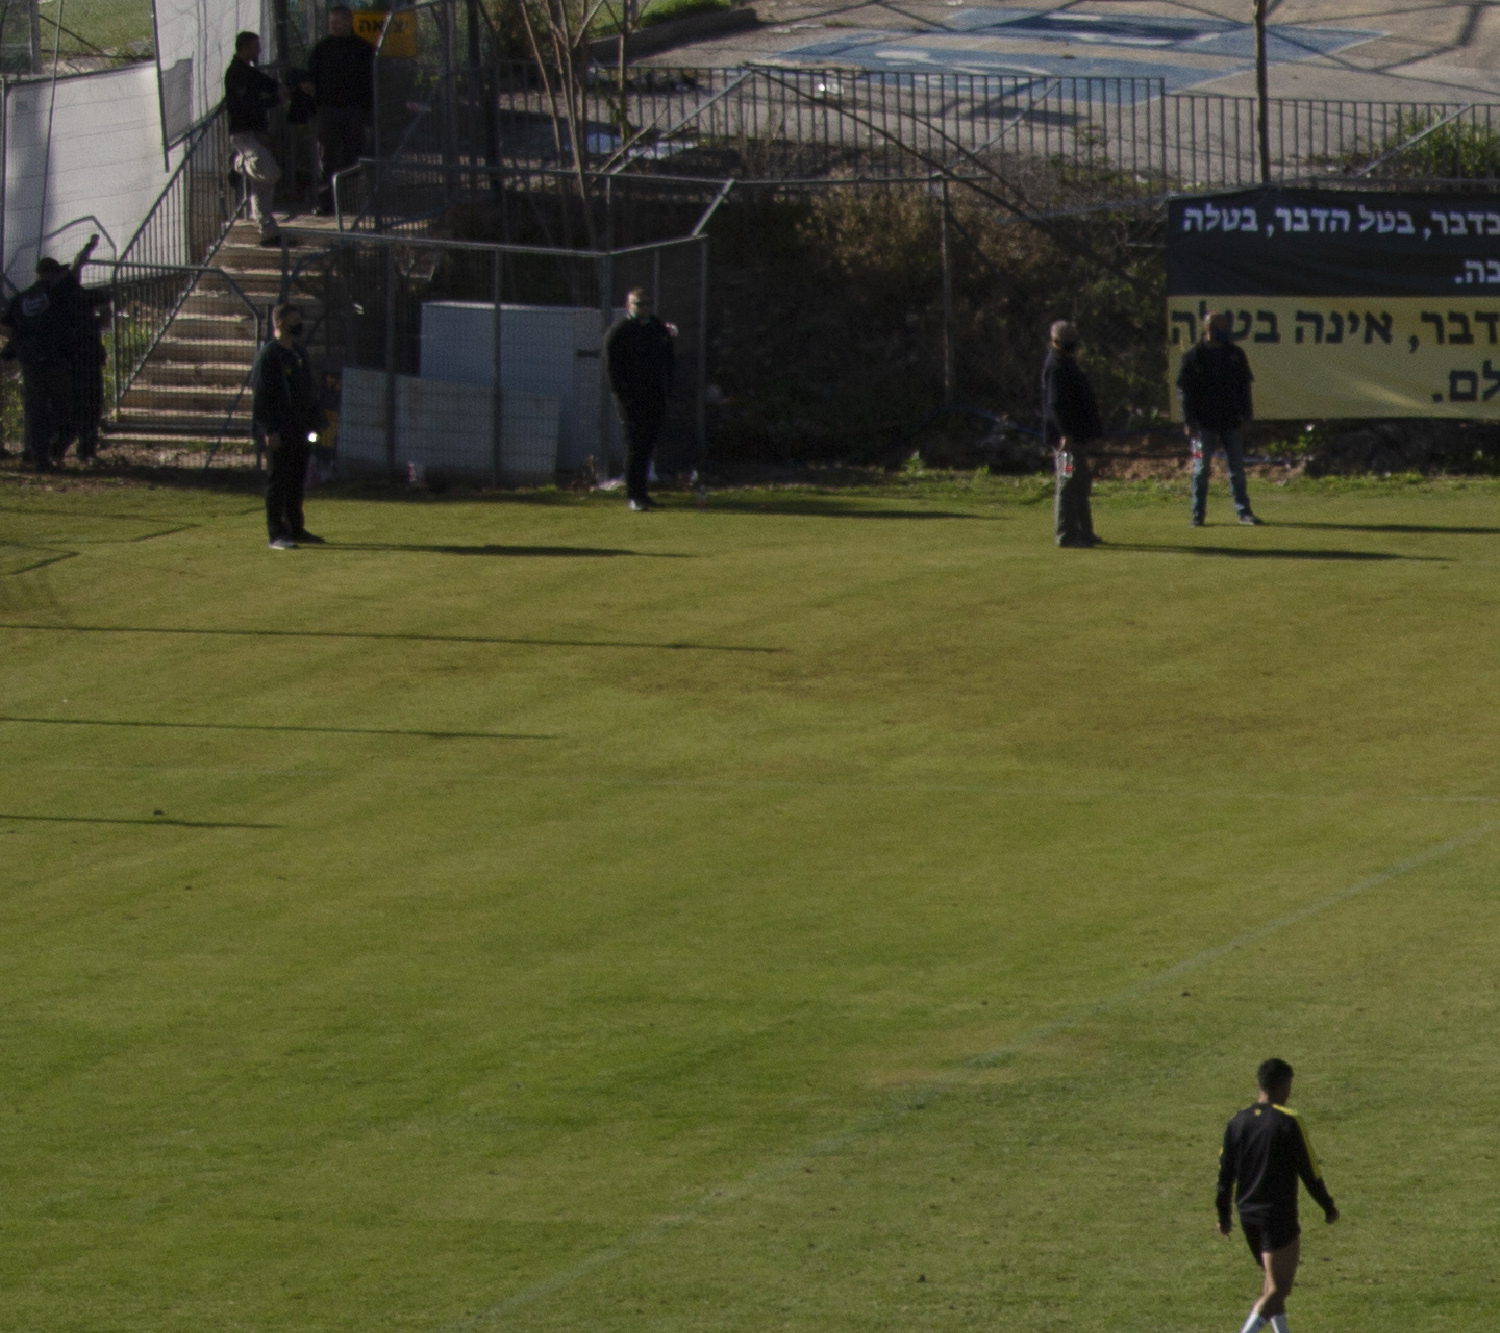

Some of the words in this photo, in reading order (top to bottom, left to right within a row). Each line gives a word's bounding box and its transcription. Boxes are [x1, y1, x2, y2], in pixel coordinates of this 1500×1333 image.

[1182, 202, 1259, 232] בטלה
[1266, 207, 1351, 239] הדבר,
[1358, 204, 1415, 235] בטל
[1294, 310, 1393, 344] אינה
